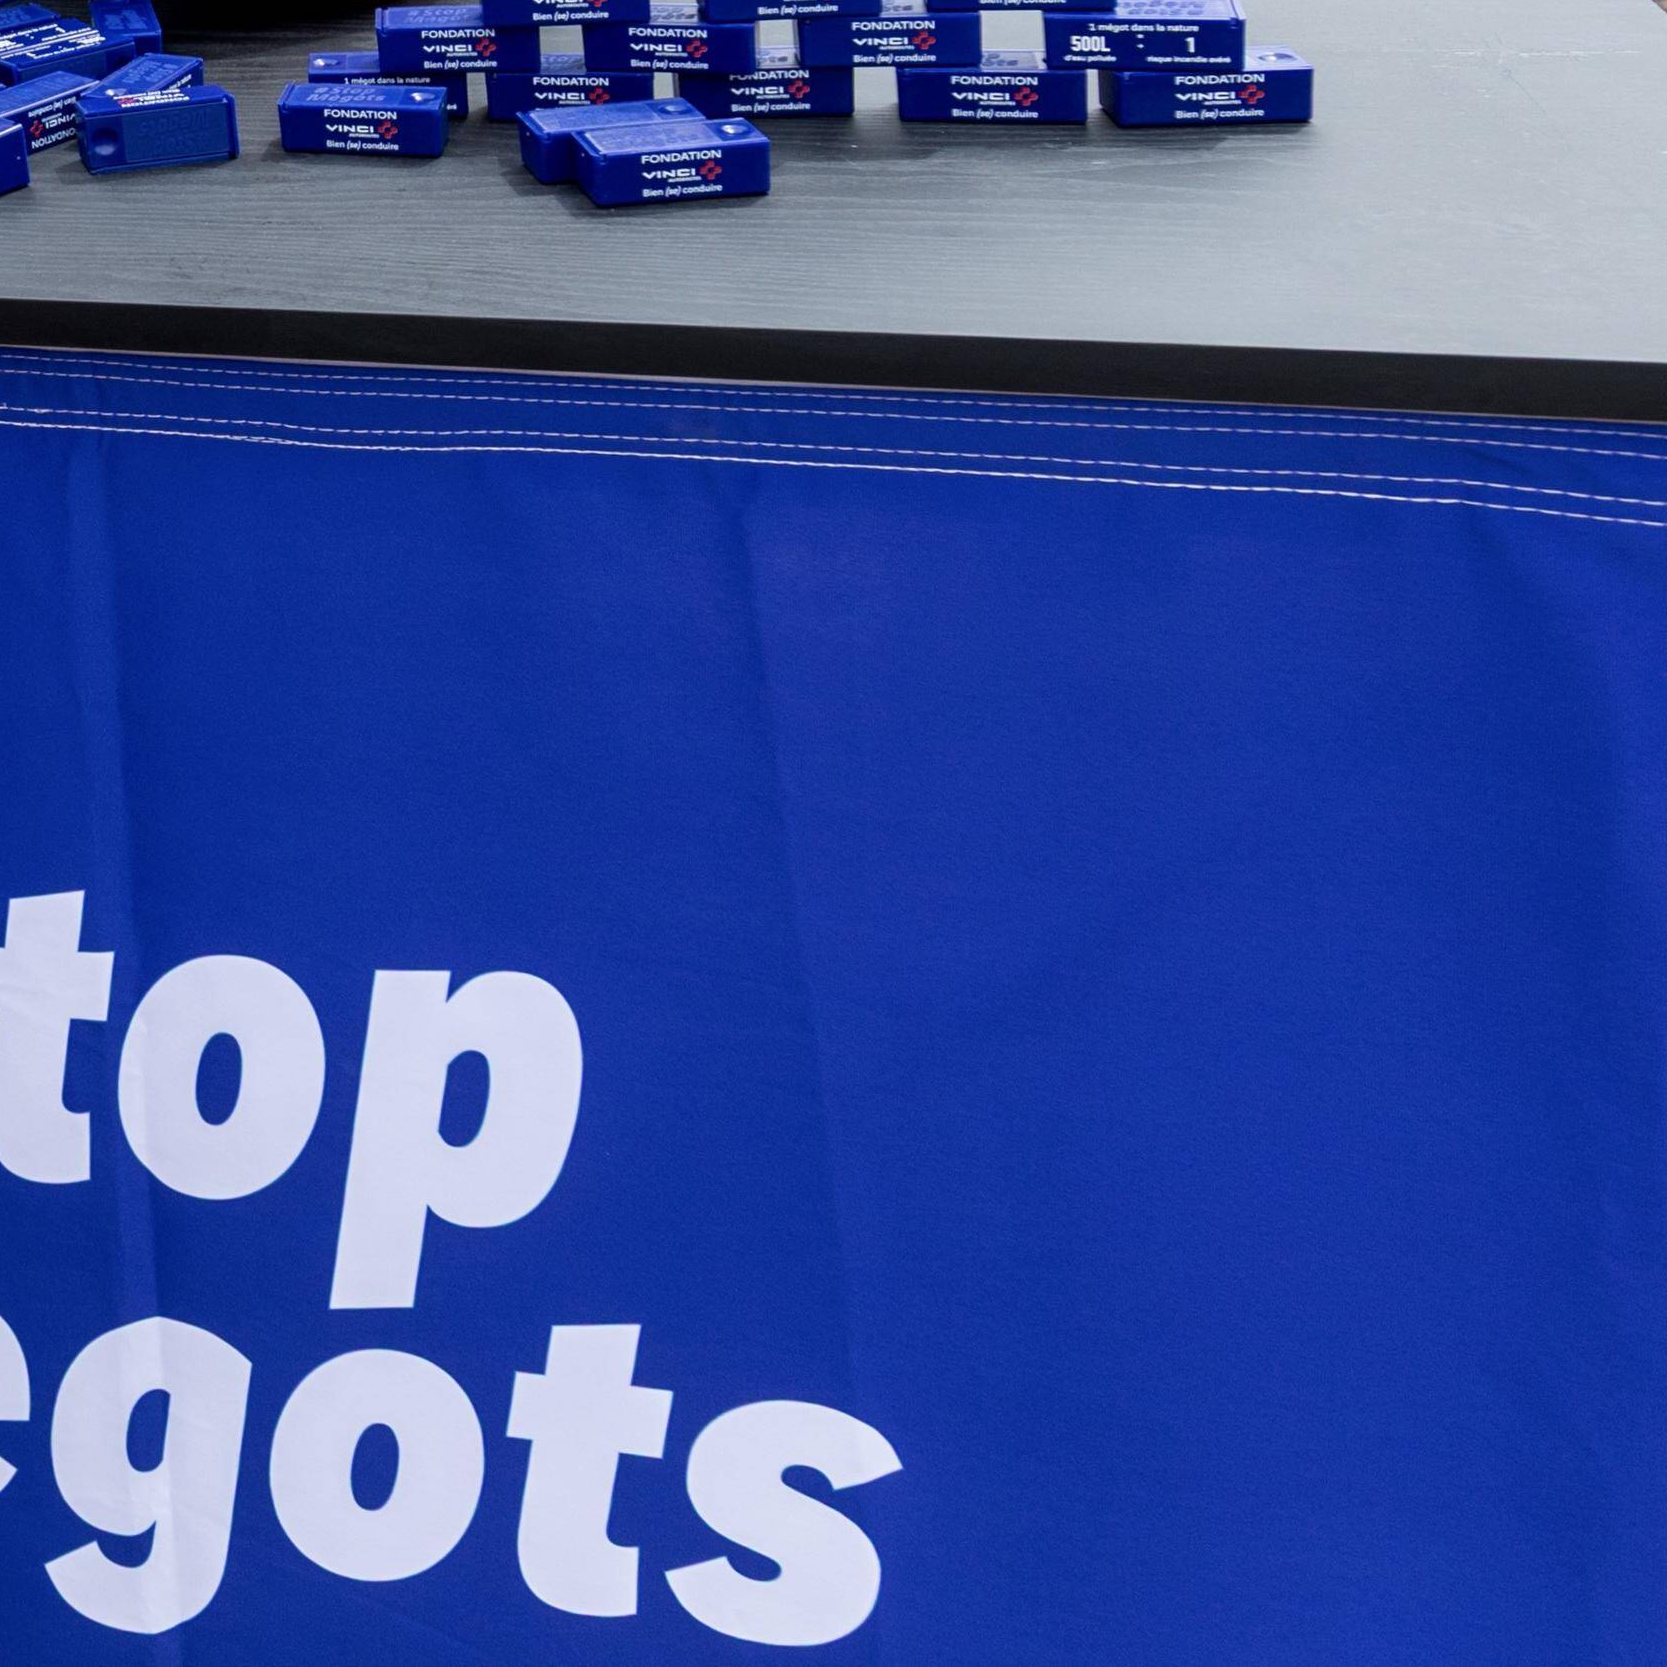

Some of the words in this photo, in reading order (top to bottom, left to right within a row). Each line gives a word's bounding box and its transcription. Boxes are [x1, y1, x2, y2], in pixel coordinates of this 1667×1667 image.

[851, 20, 936, 31] FONDATION
[421, 29, 496, 39] FONDATION
[628, 27, 708, 38] FONDATION
[852, 37, 909, 46] VINCI
[1071, 36, 1111, 52] 500L
[1185, 37, 1195, 53] 1
[423, 44, 472, 53] VINCI
[630, 43, 682, 52] VINCI
[533, 76, 610, 86] FONDATION
[950, 76, 1038, 86] FONDATION
[1175, 74, 1265, 85] FONDATION
[730, 86, 785, 95] VINCI
[535, 92, 585, 101] VINCI
[952, 92, 1010, 101] VINCI
[1175, 91, 1236, 101] VINCI
[323, 109, 397, 119] FONDATION
[325, 124, 374, 133] VINCI
[31, 127, 76, 149] ONDATION
[641, 149, 722, 165] FONDATION
[642, 167, 696, 180] VINCI
